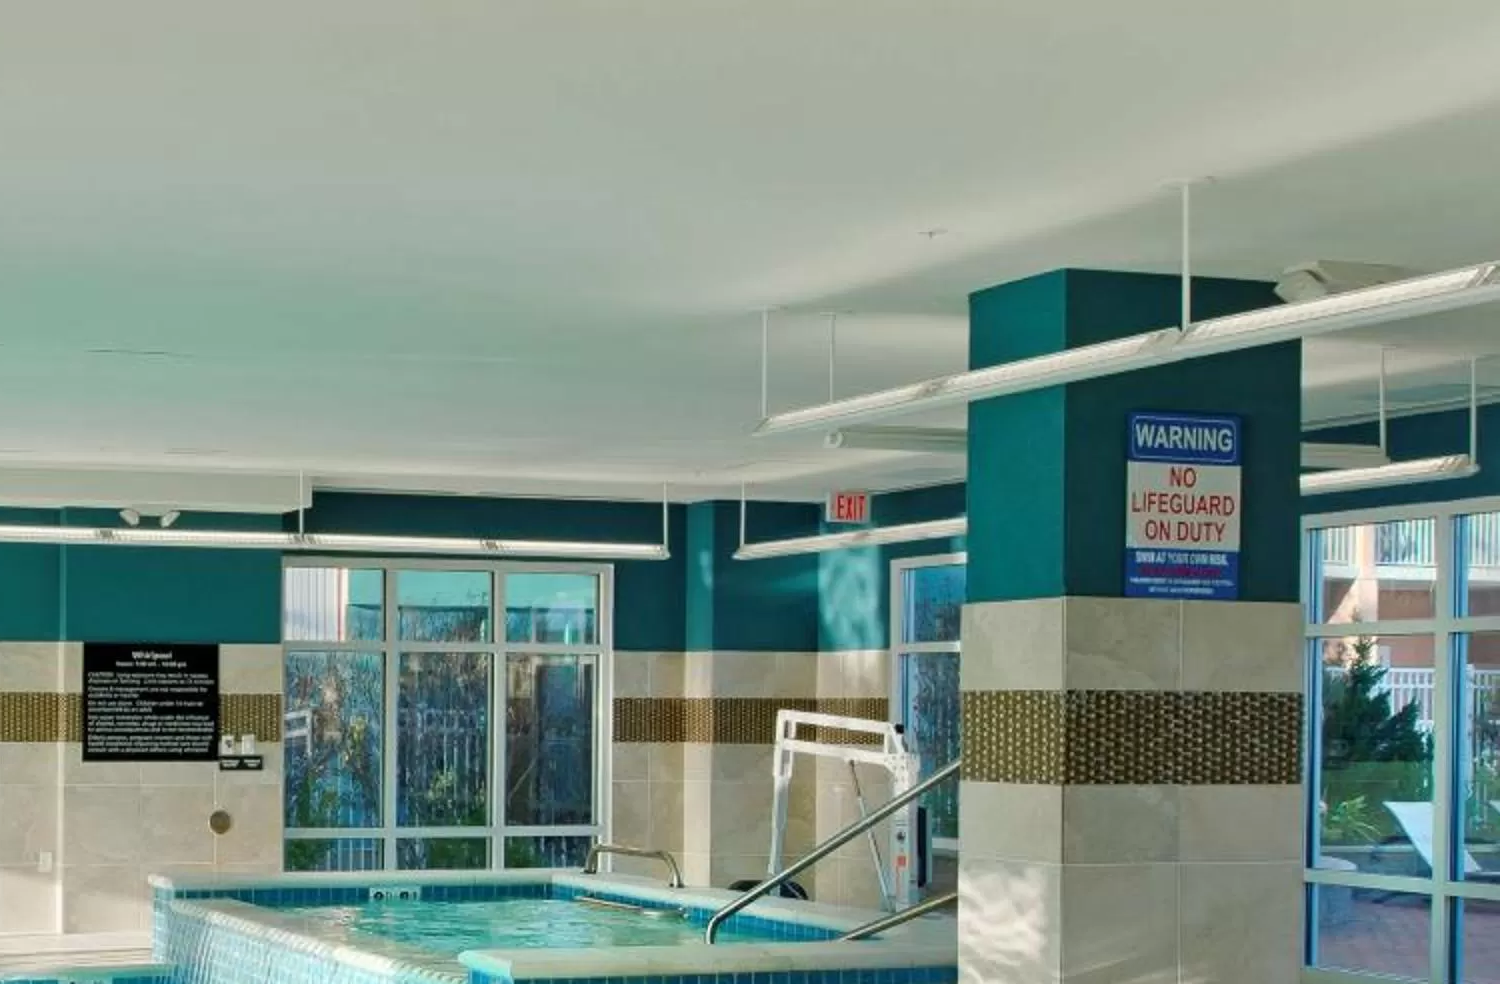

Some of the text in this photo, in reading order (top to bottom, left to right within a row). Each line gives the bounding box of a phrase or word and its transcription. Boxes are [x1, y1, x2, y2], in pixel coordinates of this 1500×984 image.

[1135, 423, 1234, 453] WARNING
[1169, 466, 1197, 488] NO
[837, 495, 866, 520] EXIT
[1131, 493, 1235, 517] LIFEGUARD
[1145, 520, 1226, 542] ON DUTY
